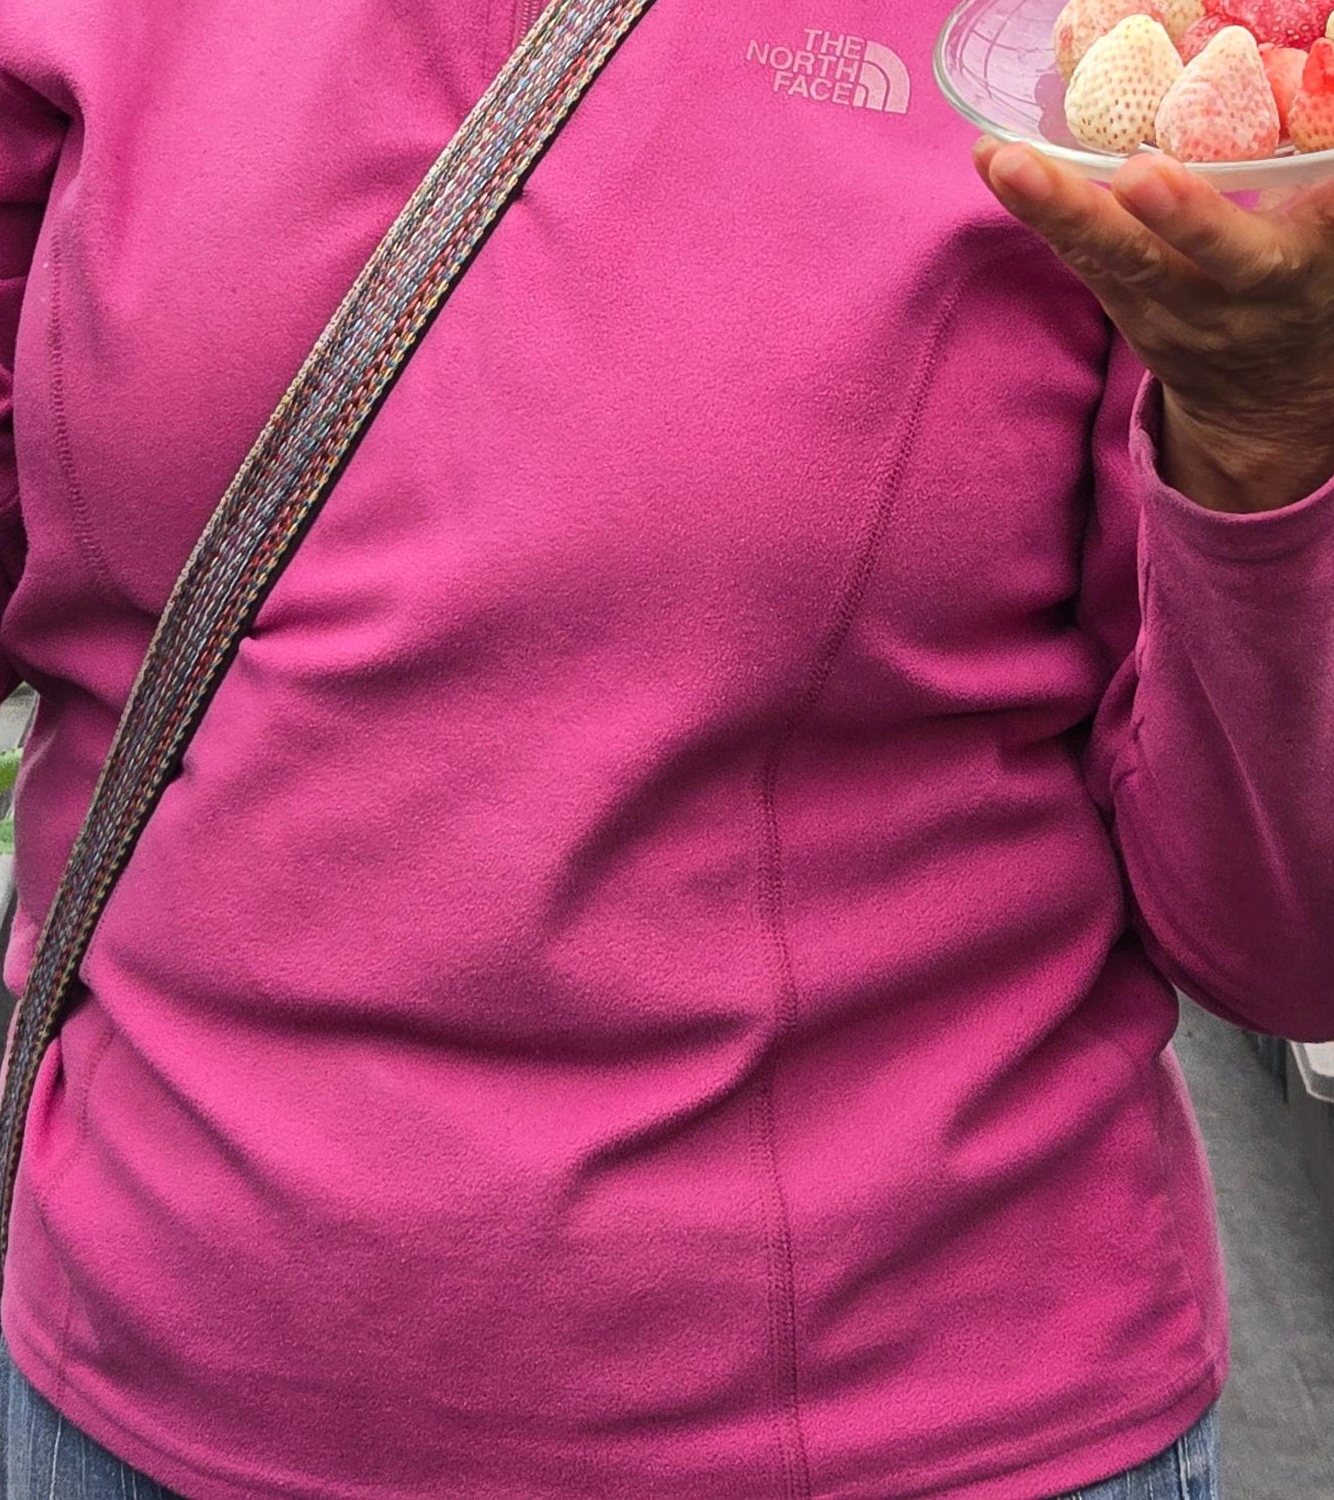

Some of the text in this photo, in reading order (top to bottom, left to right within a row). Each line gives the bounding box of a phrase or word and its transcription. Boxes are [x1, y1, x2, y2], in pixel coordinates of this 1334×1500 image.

[803, 27, 865, 59] THE
[746, 39, 859, 83] NORTH
[773, 71, 854, 106] FACE
